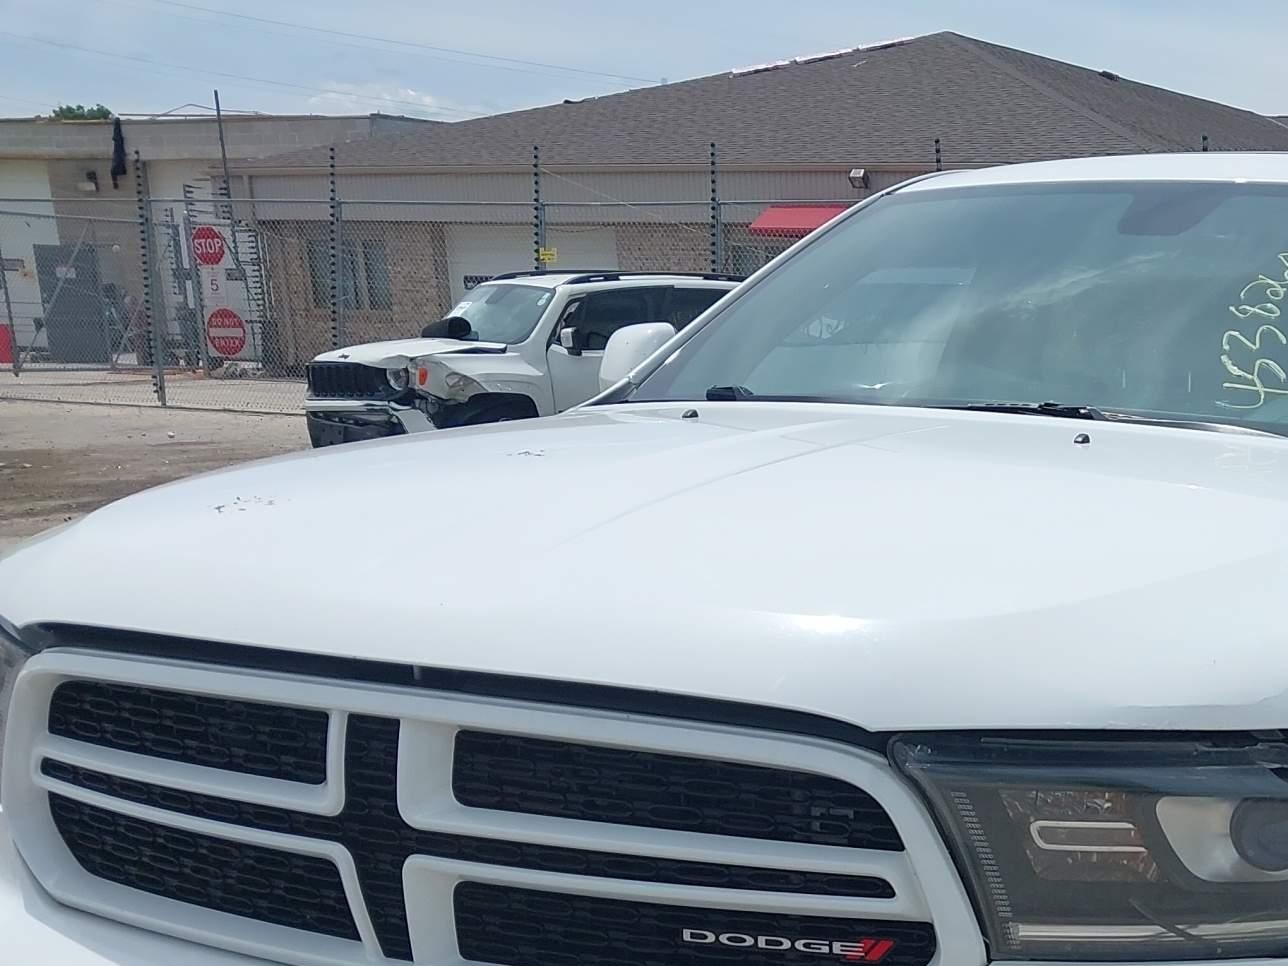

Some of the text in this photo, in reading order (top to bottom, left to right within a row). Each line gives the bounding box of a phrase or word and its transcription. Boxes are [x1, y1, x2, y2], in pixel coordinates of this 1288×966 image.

[194, 239, 221, 253] STOP
[210, 279, 219, 291] 5
[682, 928, 865, 956] DODGE
